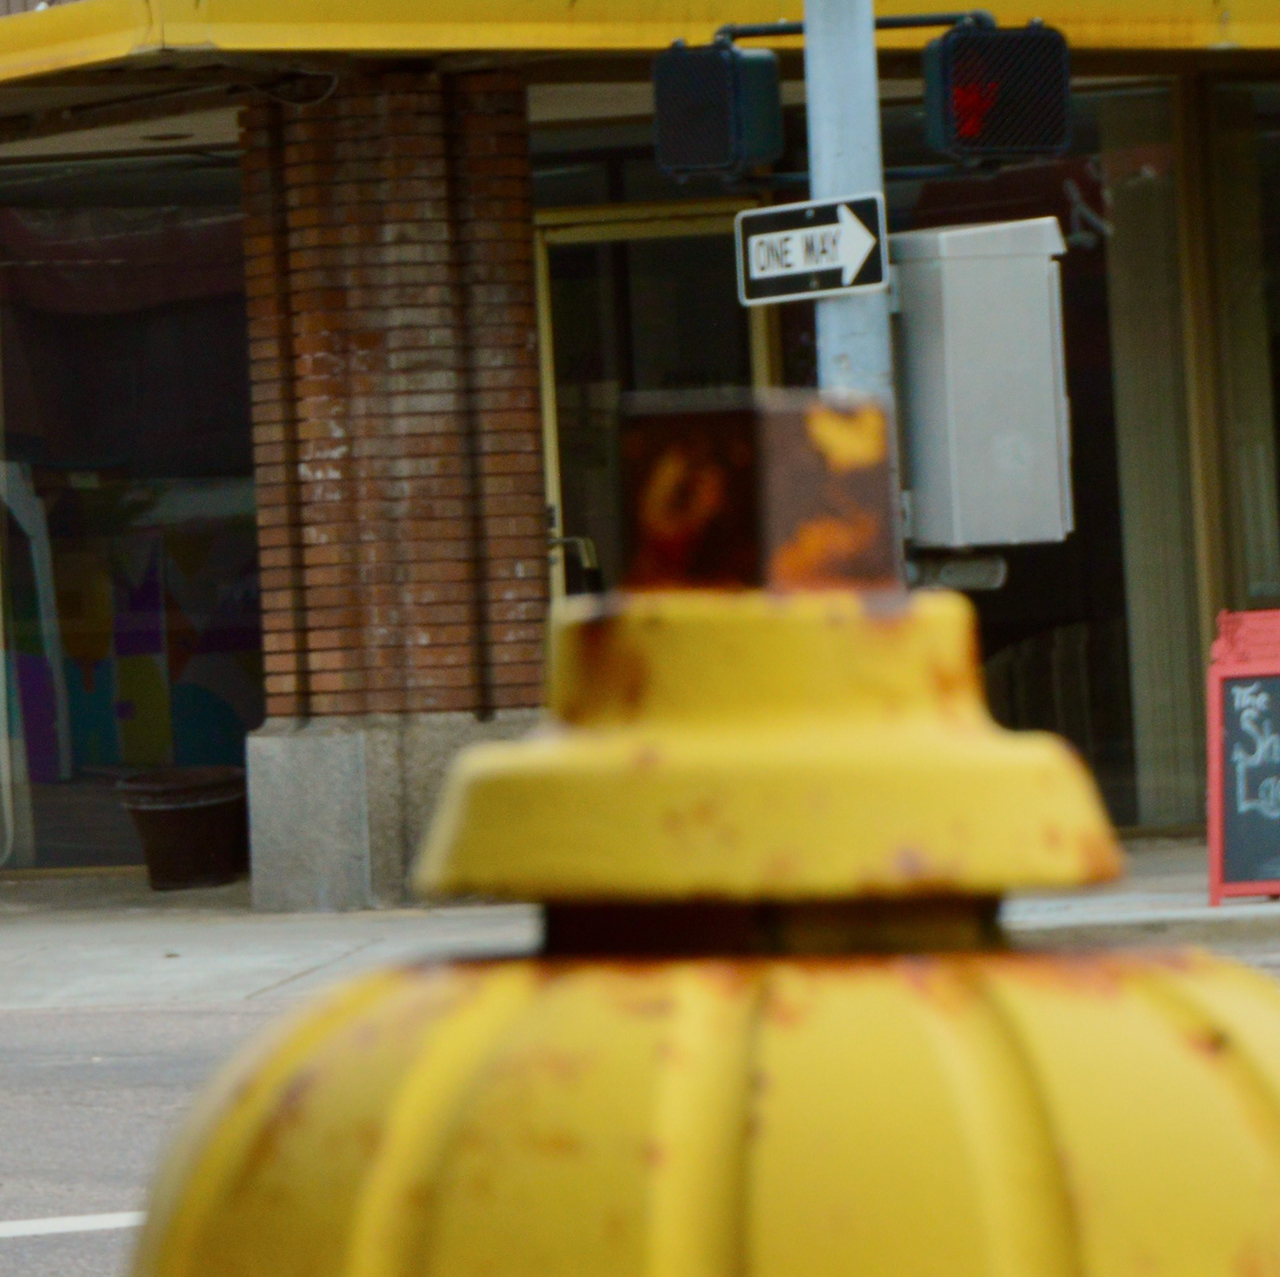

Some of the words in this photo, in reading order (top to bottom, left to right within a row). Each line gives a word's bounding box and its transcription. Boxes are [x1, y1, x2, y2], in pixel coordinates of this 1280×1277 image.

[755, 235, 793, 272] ONE
[801, 229, 840, 264] WAY
[1231, 681, 1270, 710] The
